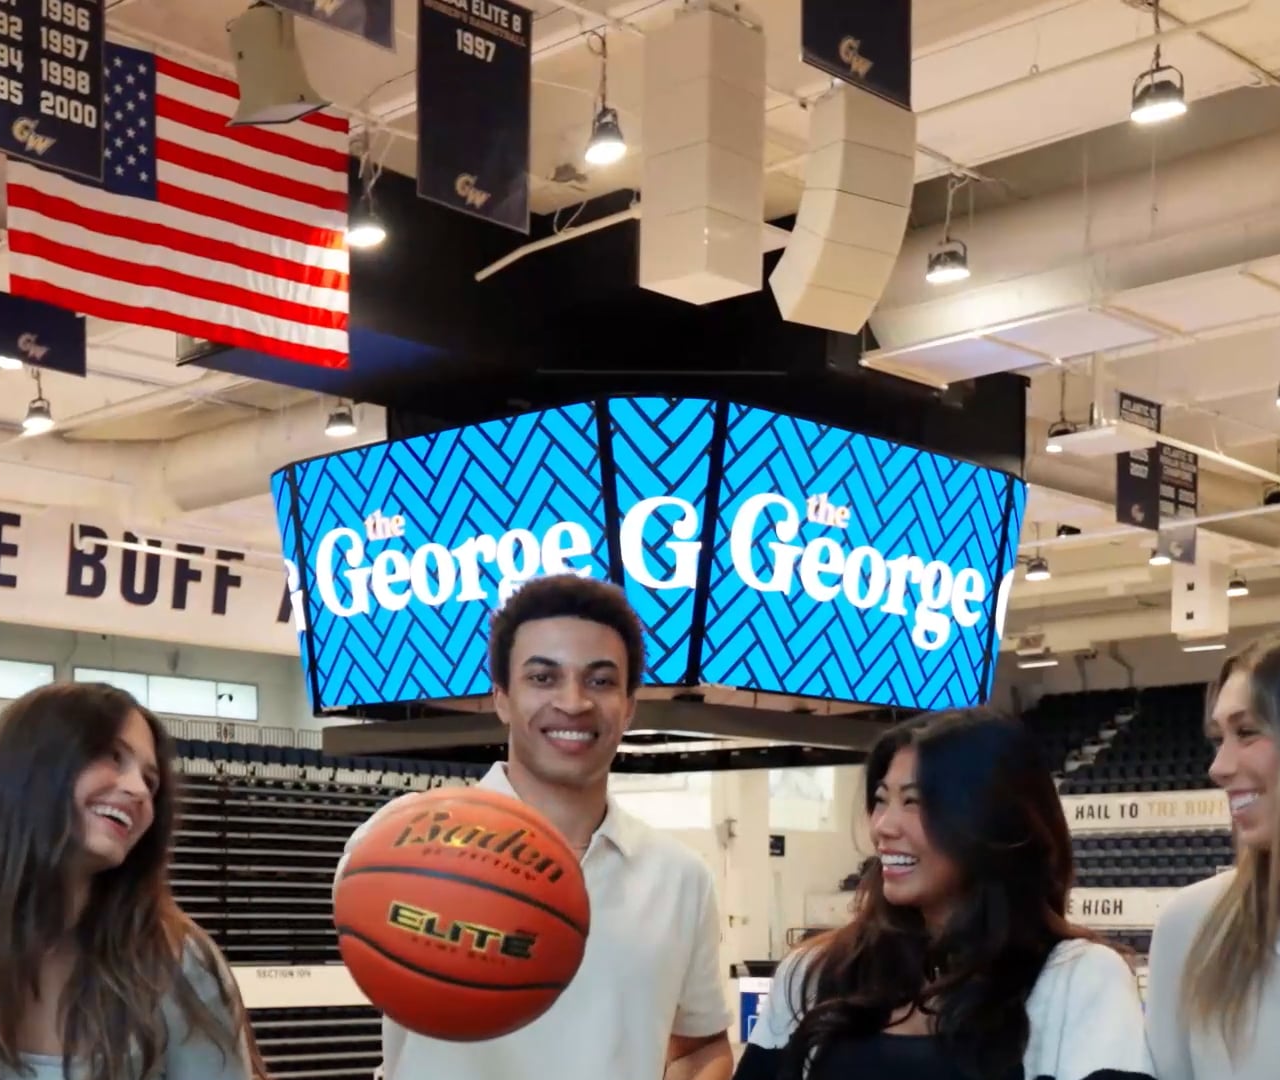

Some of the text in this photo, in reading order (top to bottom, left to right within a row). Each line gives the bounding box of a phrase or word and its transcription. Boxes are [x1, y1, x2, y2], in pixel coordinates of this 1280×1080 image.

[40, 0, 90, 32] 1996
[471, 0, 509, 28] ELITE
[40, 26, 88, 62] 1997
[456, 28, 496, 62] 1997
[40, 58, 90, 95] 1998
[40, 90, 97, 128] 2000
[365, 507, 405, 541] the
[805, 492, 851, 529] the
[620, 495, 702, 590] G
[66, 523, 245, 616] BUFF
[316, 521, 593, 618] George
[729, 492, 985, 650] George
[1074, 804, 1111, 820] HAIL
[1120, 803, 1139, 819] TO
[394, 811, 564, 884] Baden
[1082, 899, 1124, 916] HIGH
[387, 900, 538, 960] ELITE
